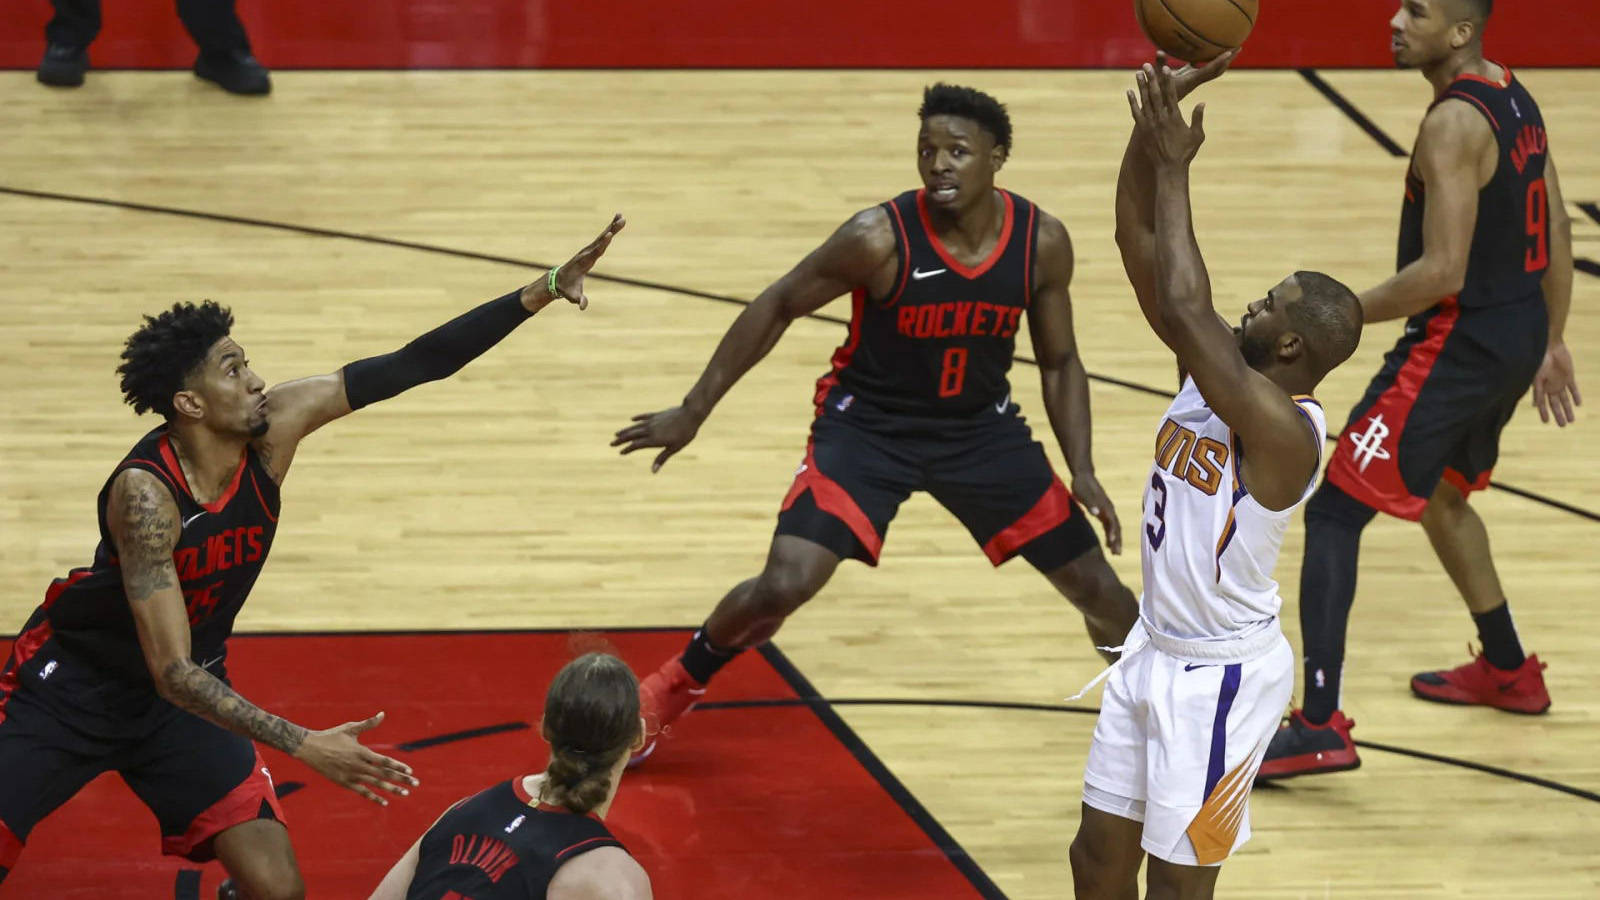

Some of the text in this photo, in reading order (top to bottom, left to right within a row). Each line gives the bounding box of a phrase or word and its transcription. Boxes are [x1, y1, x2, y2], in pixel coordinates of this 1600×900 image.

[1525, 178, 1550, 272] 9
[897, 300, 1024, 339] ROCKETS
[938, 347, 969, 398] 8
[1146, 471, 1167, 552] 3
[448, 833, 521, 884] OLYNYK
